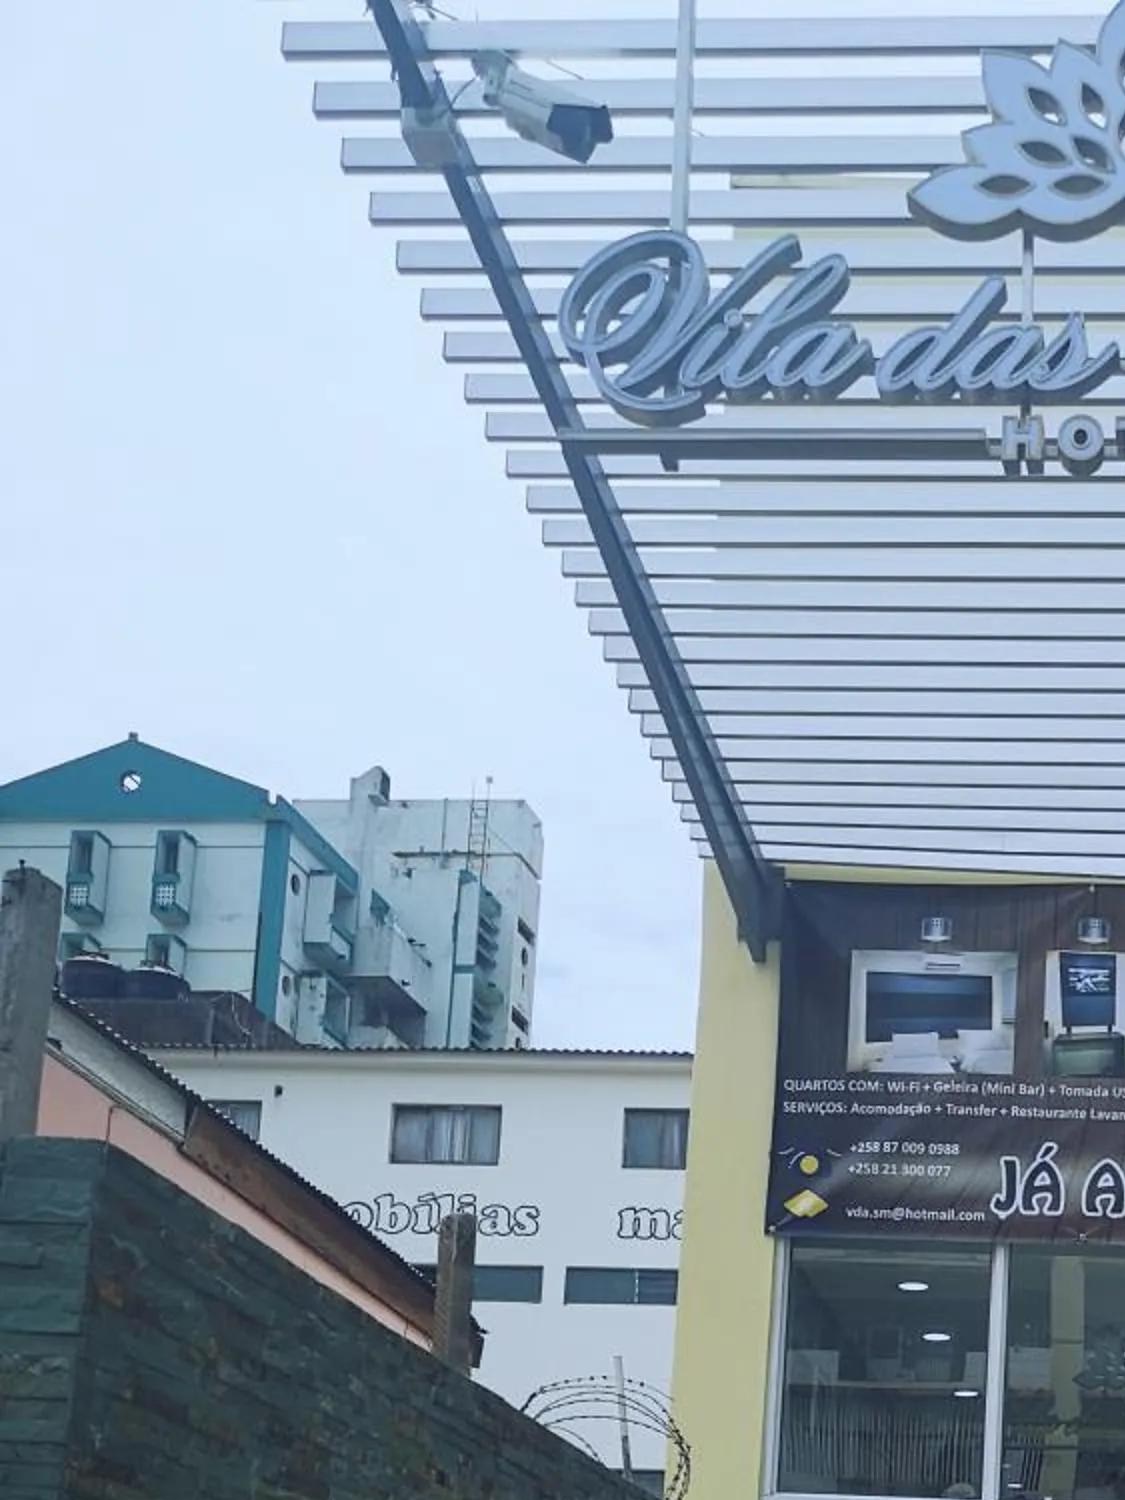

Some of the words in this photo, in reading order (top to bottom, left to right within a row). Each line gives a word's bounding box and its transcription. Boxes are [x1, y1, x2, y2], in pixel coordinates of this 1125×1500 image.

[559, 230, 872, 422] Vila
[876, 276, 1119, 400] das
[784, 1079, 845, 1092] QUARTOS
[848, 1080, 884, 1092] COM:
[934, 1081, 978, 1093] Geleira
[1019, 1084, 1045, 1097] Bar)
[1059, 1085, 1109, 1097] Tomada
[783, 1101, 848, 1115] SERVIÇOS:
[851, 1102, 931, 1116] Acomodação
[945, 1103, 997, 1116] Transfer
[1011, 1105, 1087, 1119] Restaurante
[849, 1141, 881, 1153] +258
[883, 1141, 899, 1153] 87
[848, 1163, 880, 1175] +258
[927, 1164, 951, 1177] 077
[990, 1141, 1065, 1219] JÁ
[846, 1206, 985, 1221] vda.sm@hotmail.com
